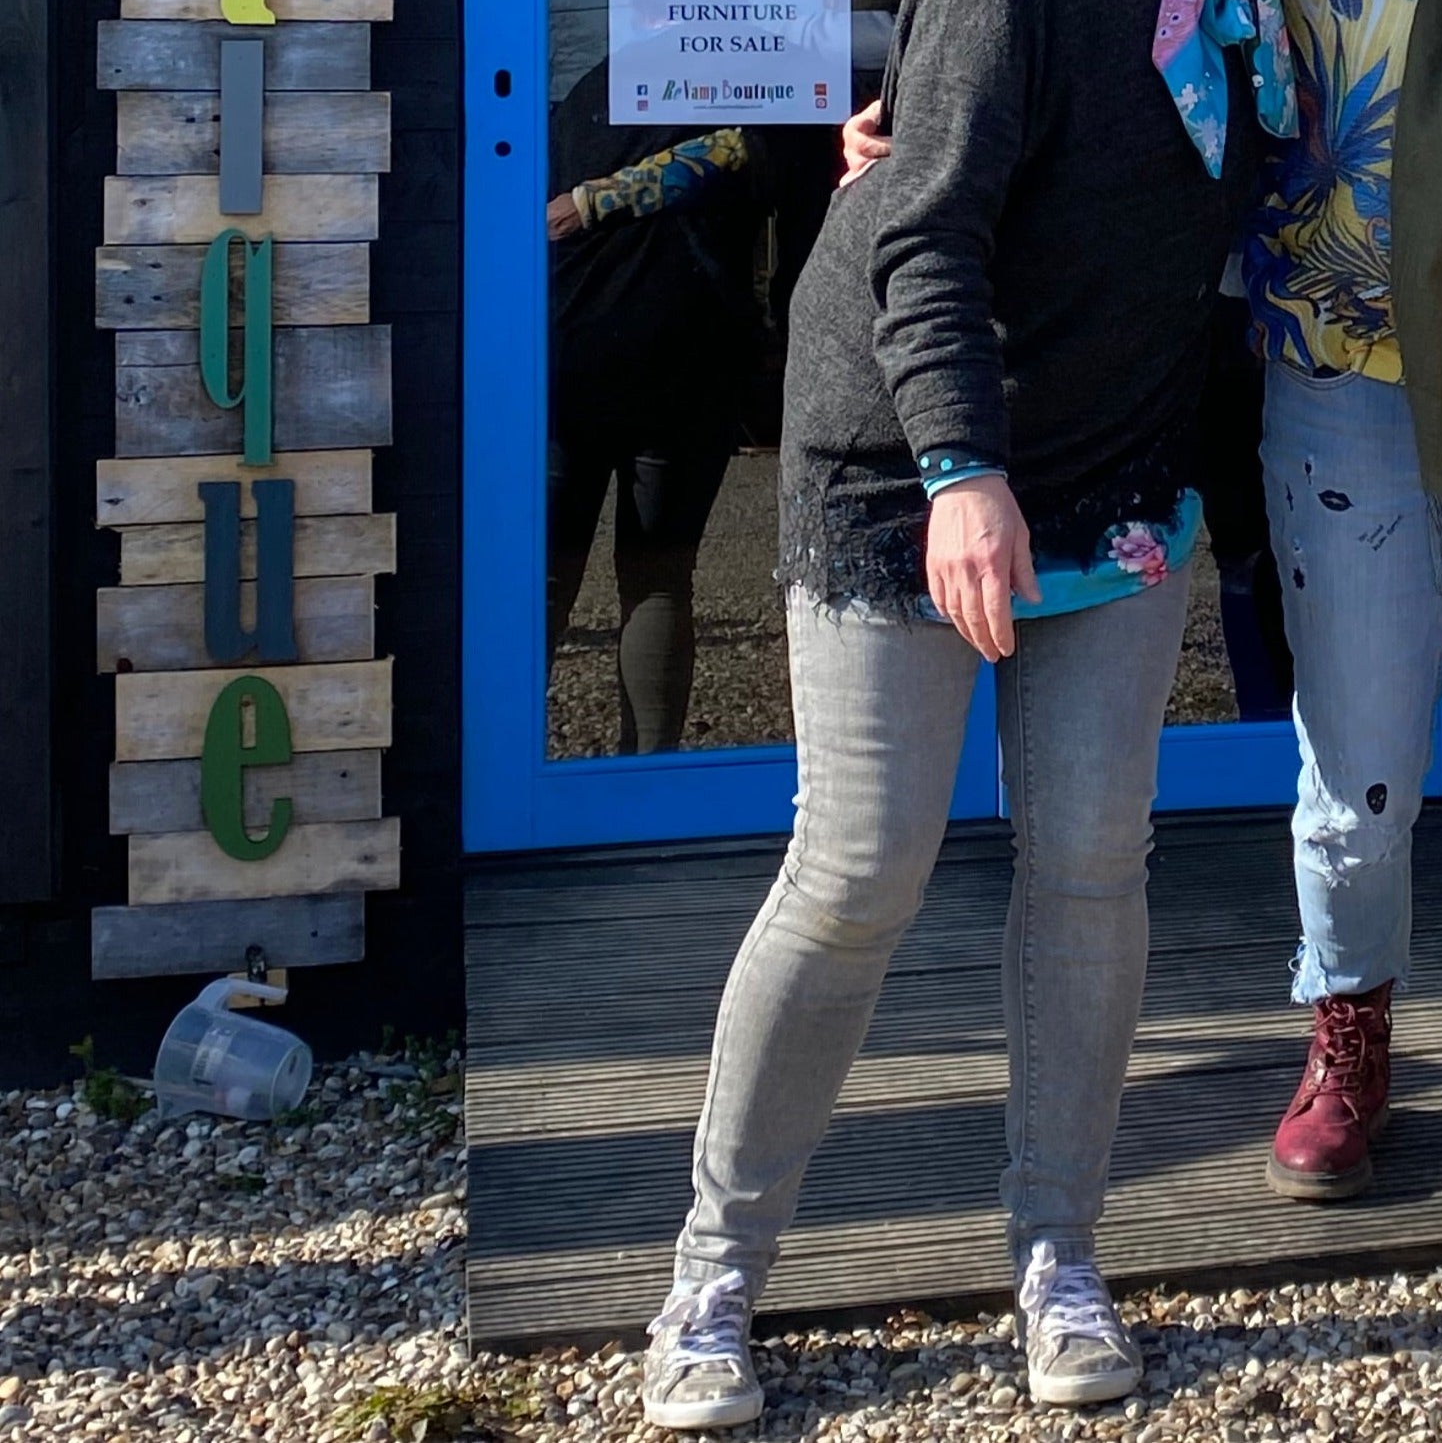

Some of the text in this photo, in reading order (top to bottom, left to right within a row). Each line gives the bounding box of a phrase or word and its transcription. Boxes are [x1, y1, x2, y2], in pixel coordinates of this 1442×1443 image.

[668, 4, 798, 21] FURNITURE
[679, 36, 785, 53] FOR SALE
[722, 79, 795, 103] Boutique
